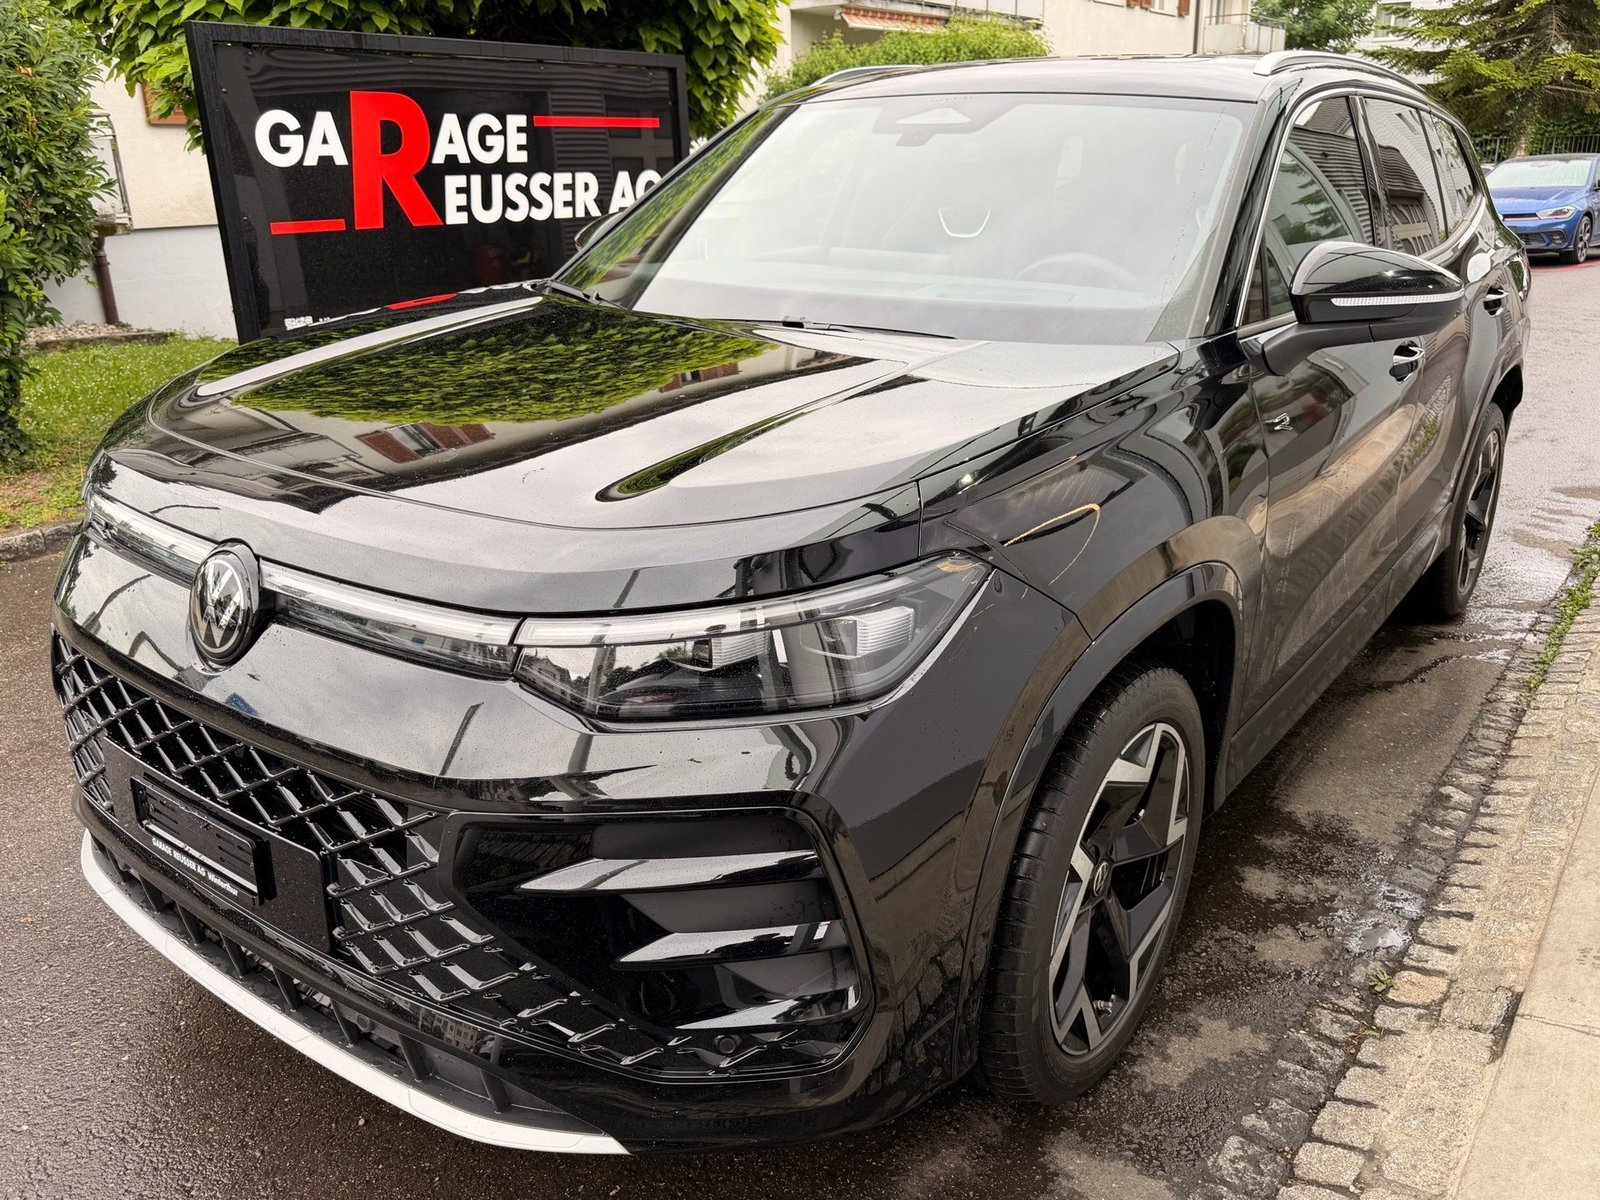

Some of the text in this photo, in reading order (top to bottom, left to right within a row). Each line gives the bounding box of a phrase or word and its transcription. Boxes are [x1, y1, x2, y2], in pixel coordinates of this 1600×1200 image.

[254, 91, 528, 230] GARAGE
[152, 837, 172, 856] GARAGE
[172, 849, 197, 871] REUSSER
[197, 863, 206, 877] AG
